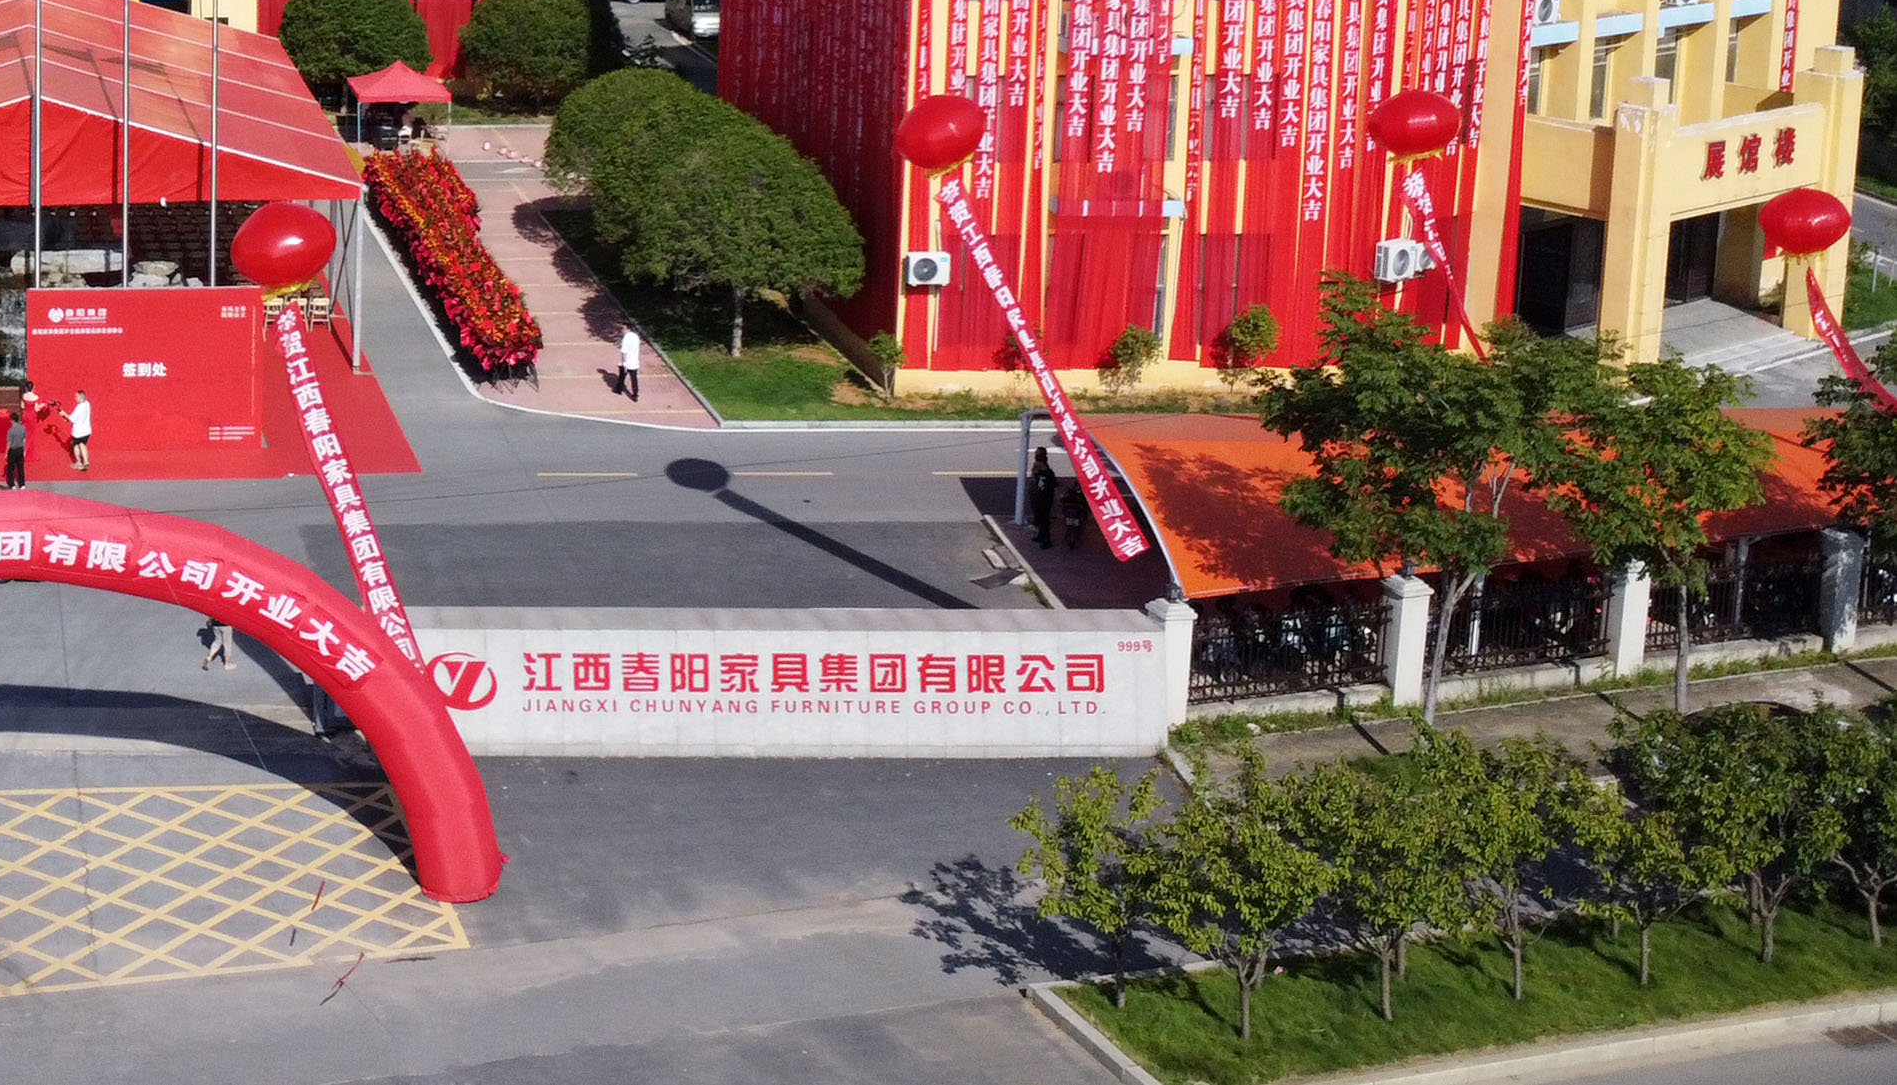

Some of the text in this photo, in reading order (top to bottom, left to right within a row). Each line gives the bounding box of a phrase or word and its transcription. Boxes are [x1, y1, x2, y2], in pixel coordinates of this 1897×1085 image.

[1699, 126, 1796, 180] 展馆楼
[122, 362, 168, 377] 签到处
[1117, 639, 1154, 653] 999号
[522, 651, 1107, 694] 江西春阳家具集团有限公司
[523, 698, 618, 715] JIANGXI
[630, 698, 759, 715] CHUNYANG
[771, 698, 902, 715] FURNITURE
[913, 698, 992, 715] GROUP
